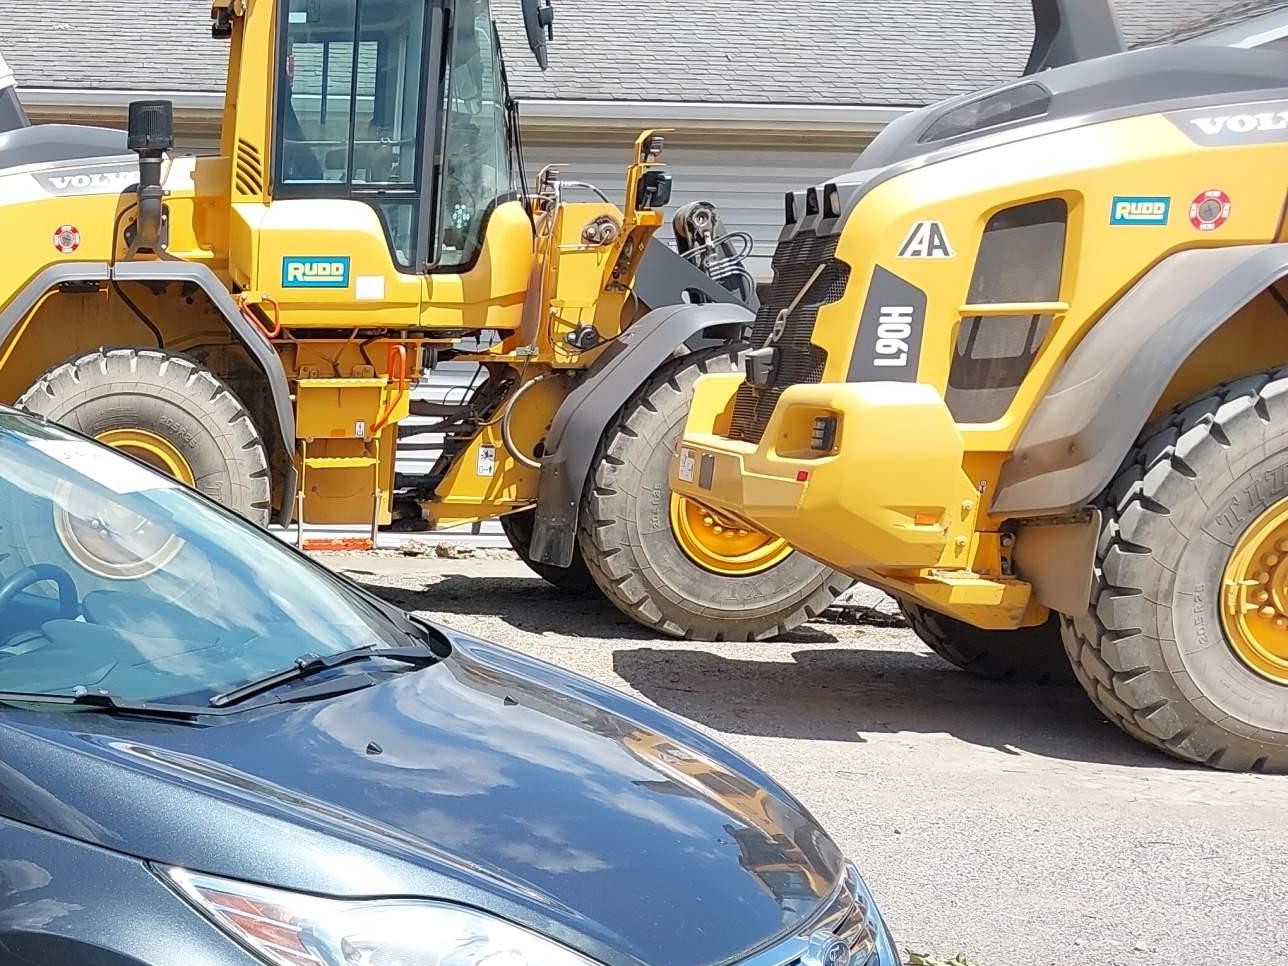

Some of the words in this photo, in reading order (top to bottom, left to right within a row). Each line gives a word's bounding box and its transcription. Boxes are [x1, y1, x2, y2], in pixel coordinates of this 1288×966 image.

[1190, 111, 1288, 135] VOL
[1115, 201, 1167, 220] RUDD
[287, 262, 345, 282] RUDD
[873, 306, 914, 366] L90H
